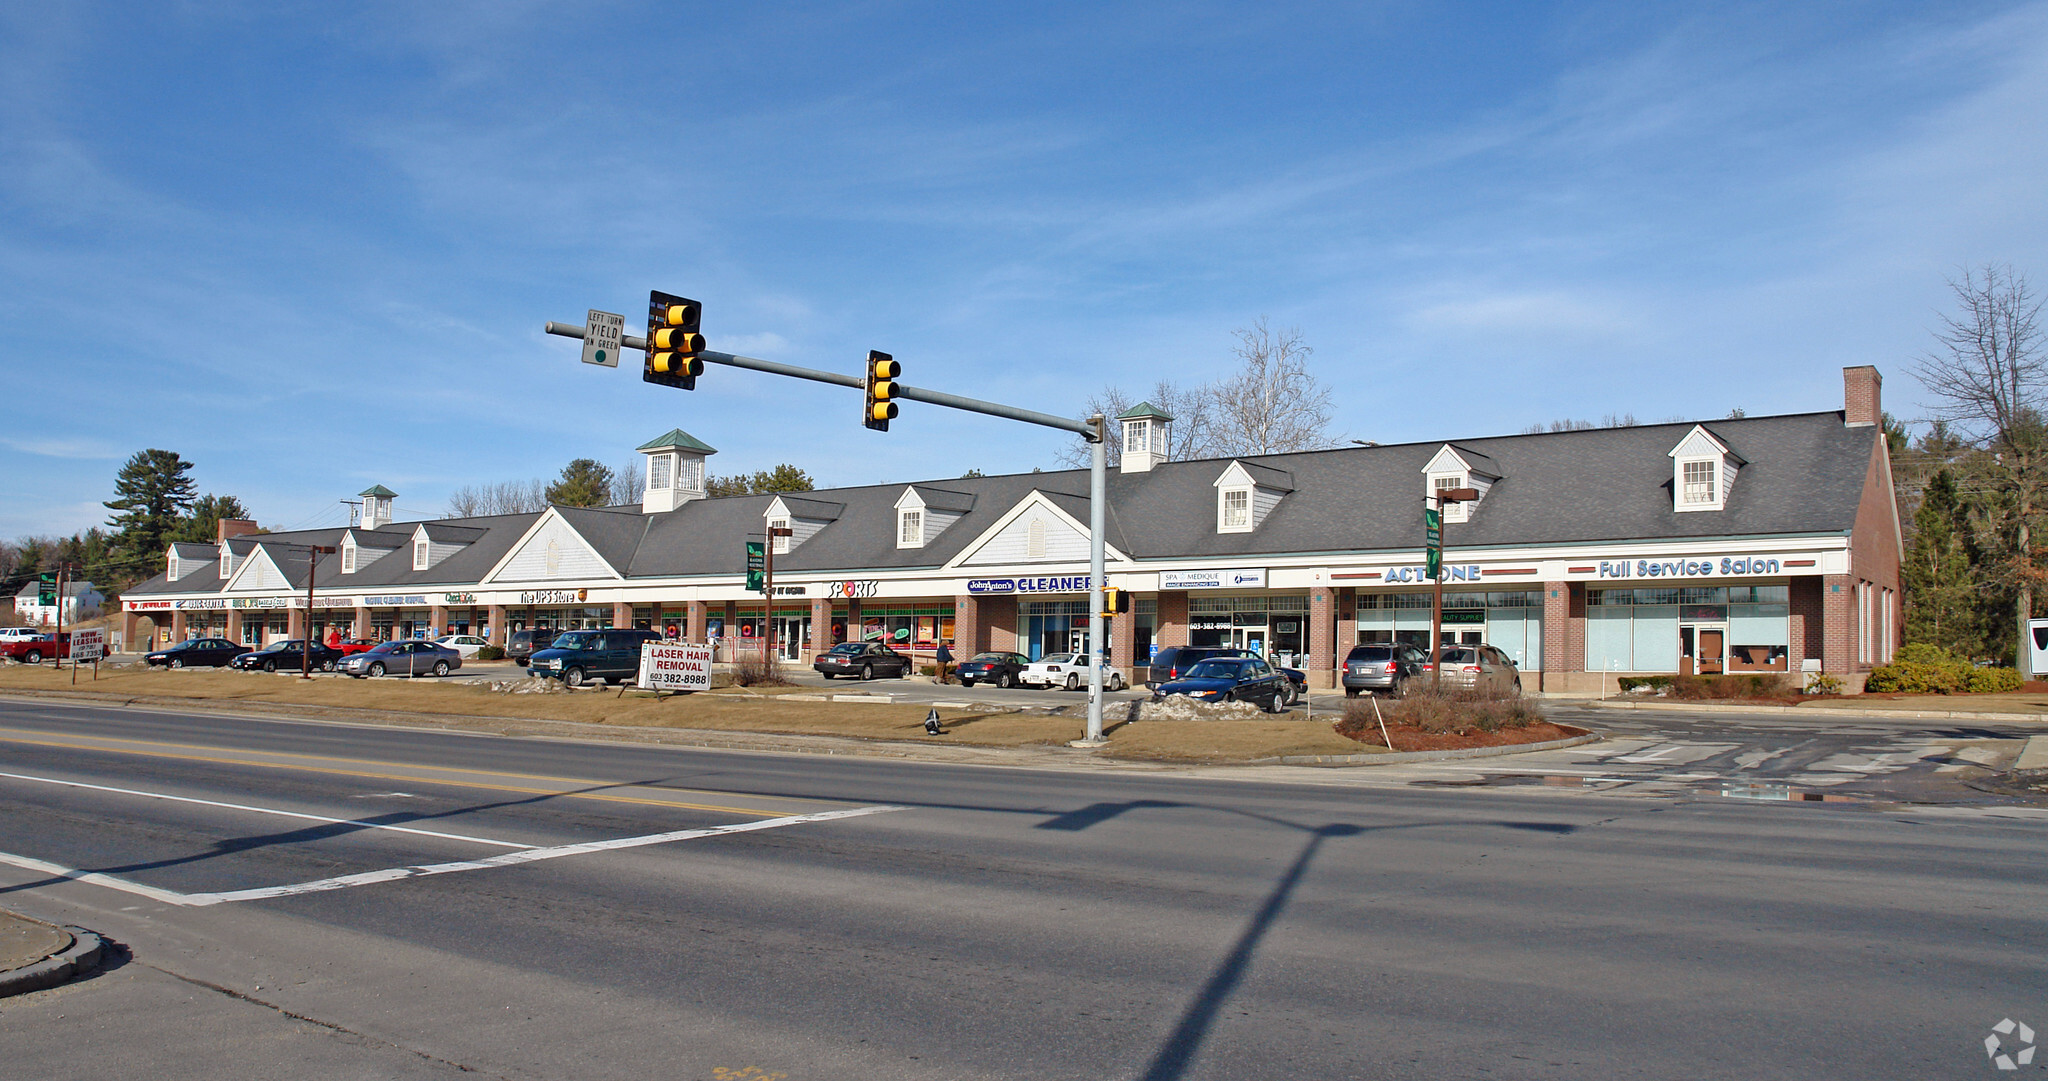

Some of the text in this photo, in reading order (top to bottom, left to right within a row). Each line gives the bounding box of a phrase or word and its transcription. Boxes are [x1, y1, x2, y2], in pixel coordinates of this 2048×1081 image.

[589, 312, 622, 326] LEFT TURN
[591, 323, 618, 339] YIELD
[585, 337, 618, 350] ON GREEN
[1599, 557, 1779, 578] Full Service Salon
[1187, 572, 1219, 580] MEDIQUE
[1384, 567, 1426, 583] ACT
[828, 580, 879, 599] SPORTS
[520, 590, 575, 604] The UPS Store
[72, 636, 103, 646] LEASING
[651, 648, 710, 661] LASER HAIR
[656, 660, 703, 672] REMOVAL
[649, 672, 707, 685] 603 382-8988
